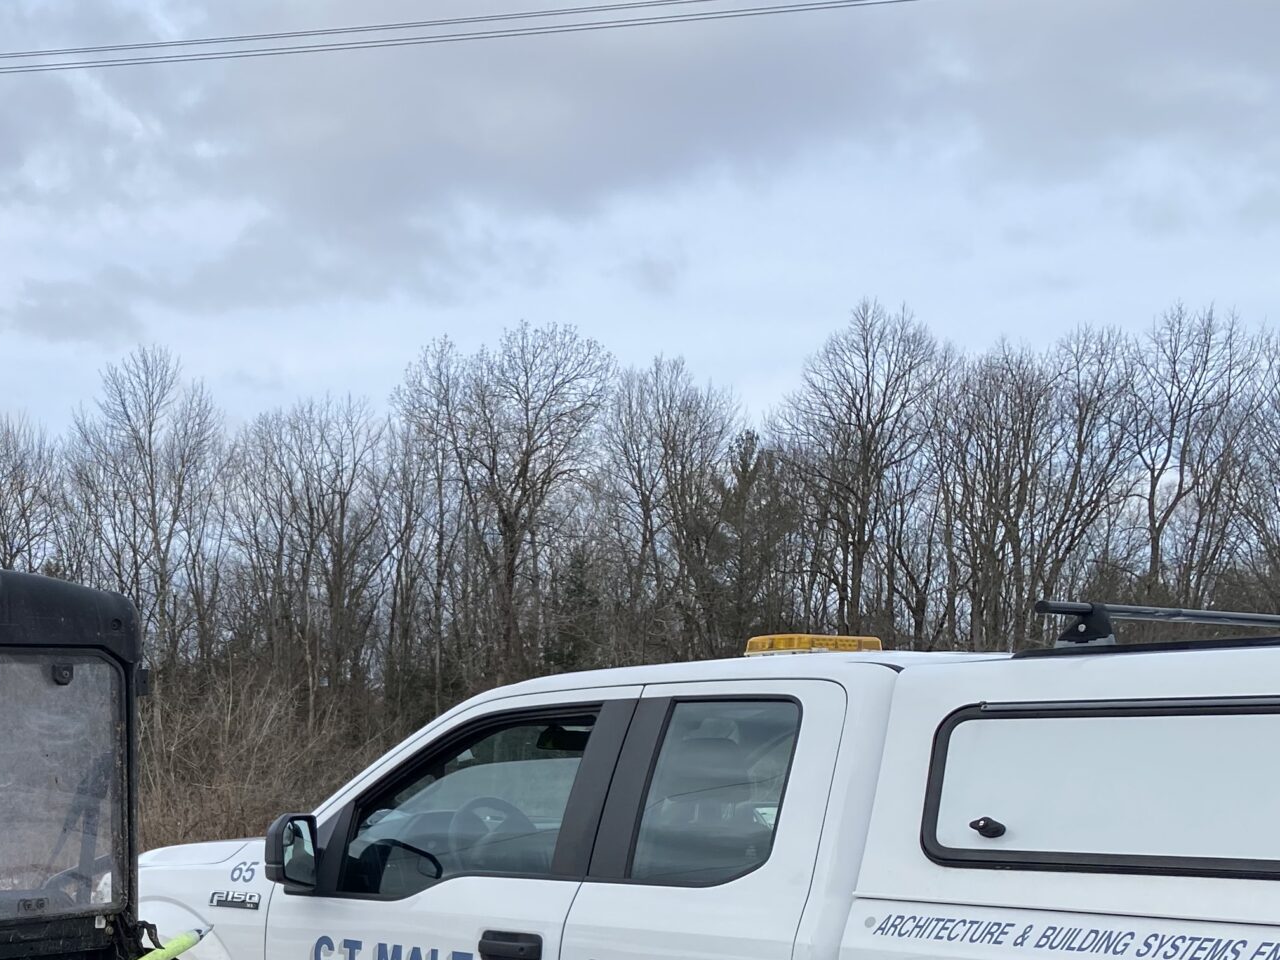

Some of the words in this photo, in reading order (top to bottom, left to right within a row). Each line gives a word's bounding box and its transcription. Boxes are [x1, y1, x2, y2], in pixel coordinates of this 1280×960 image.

[230, 861, 260, 883] 65
[873, 914, 1016, 945] ARCHITECTURE
[1013, 924, 1034, 947] &
[1034, 926, 1136, 956] BUILDING
